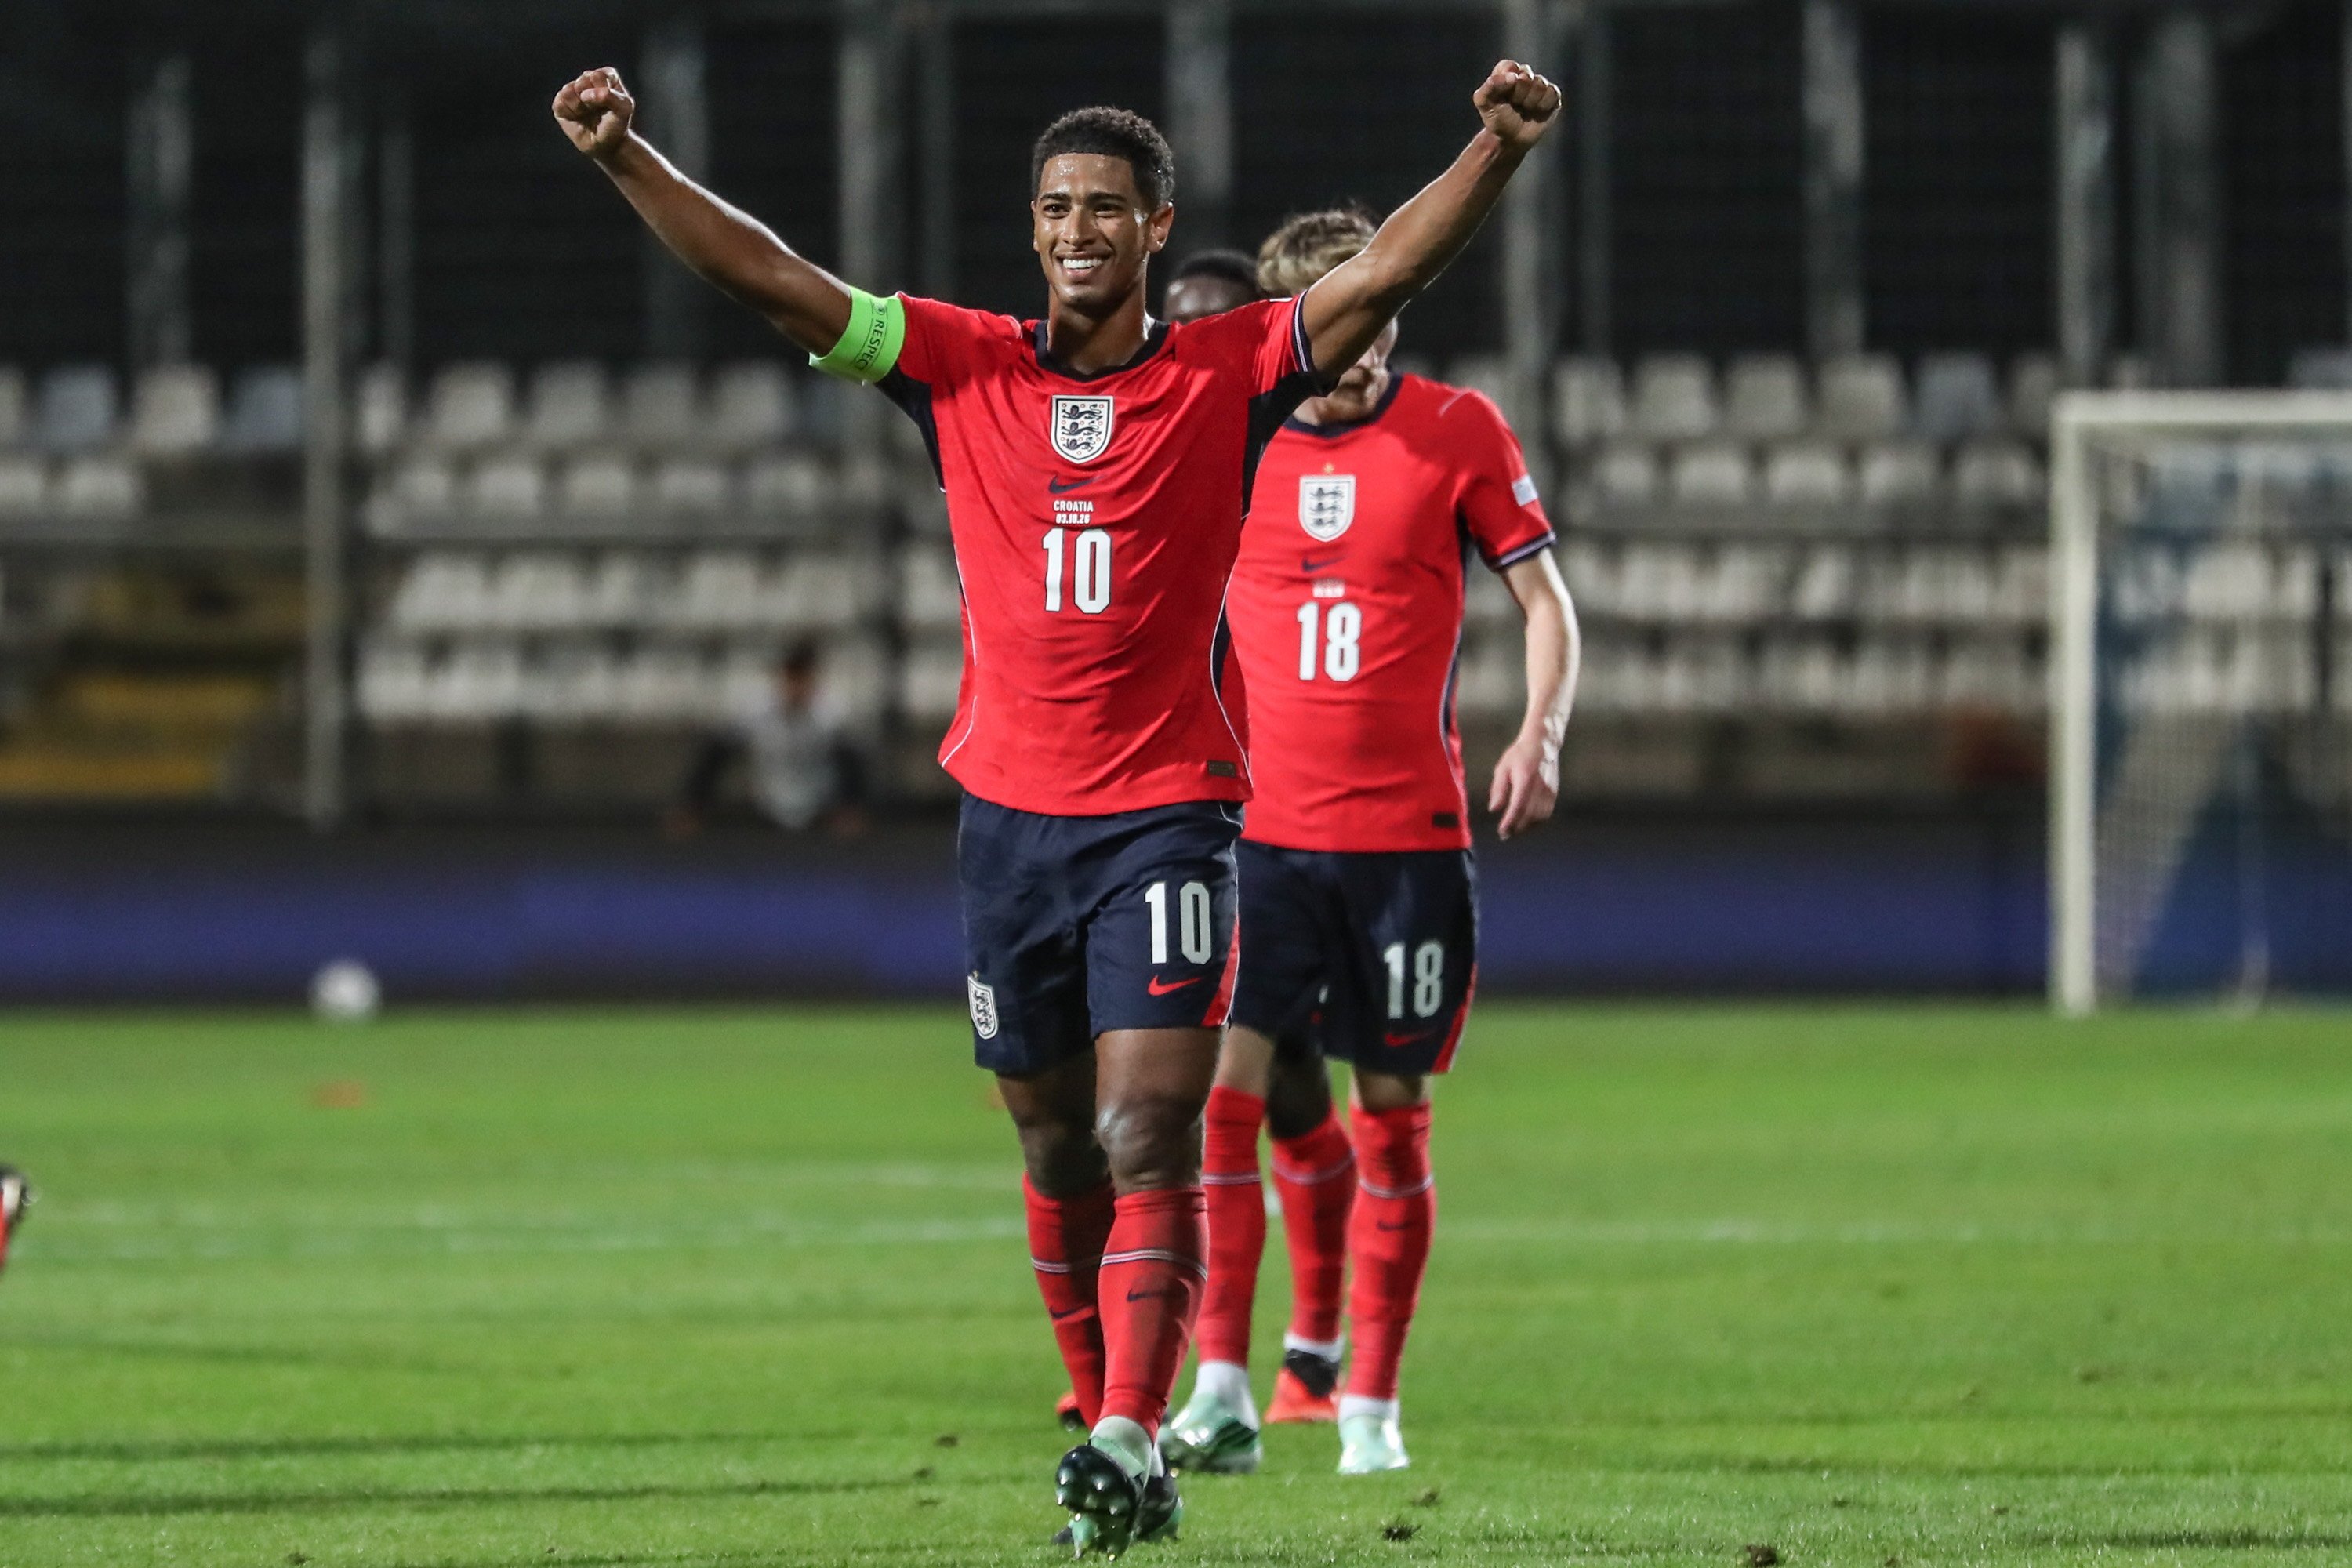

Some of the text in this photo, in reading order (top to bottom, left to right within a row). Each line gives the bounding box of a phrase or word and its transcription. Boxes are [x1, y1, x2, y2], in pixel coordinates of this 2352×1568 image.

[855, 320, 884, 370] RESPEC
[1053, 500, 1094, 512] CROATIA
[1042, 527, 1111, 614] 10
[1297, 601, 1363, 681] 18
[1145, 882, 1211, 964] 10
[1383, 938, 1443, 1019] 18
